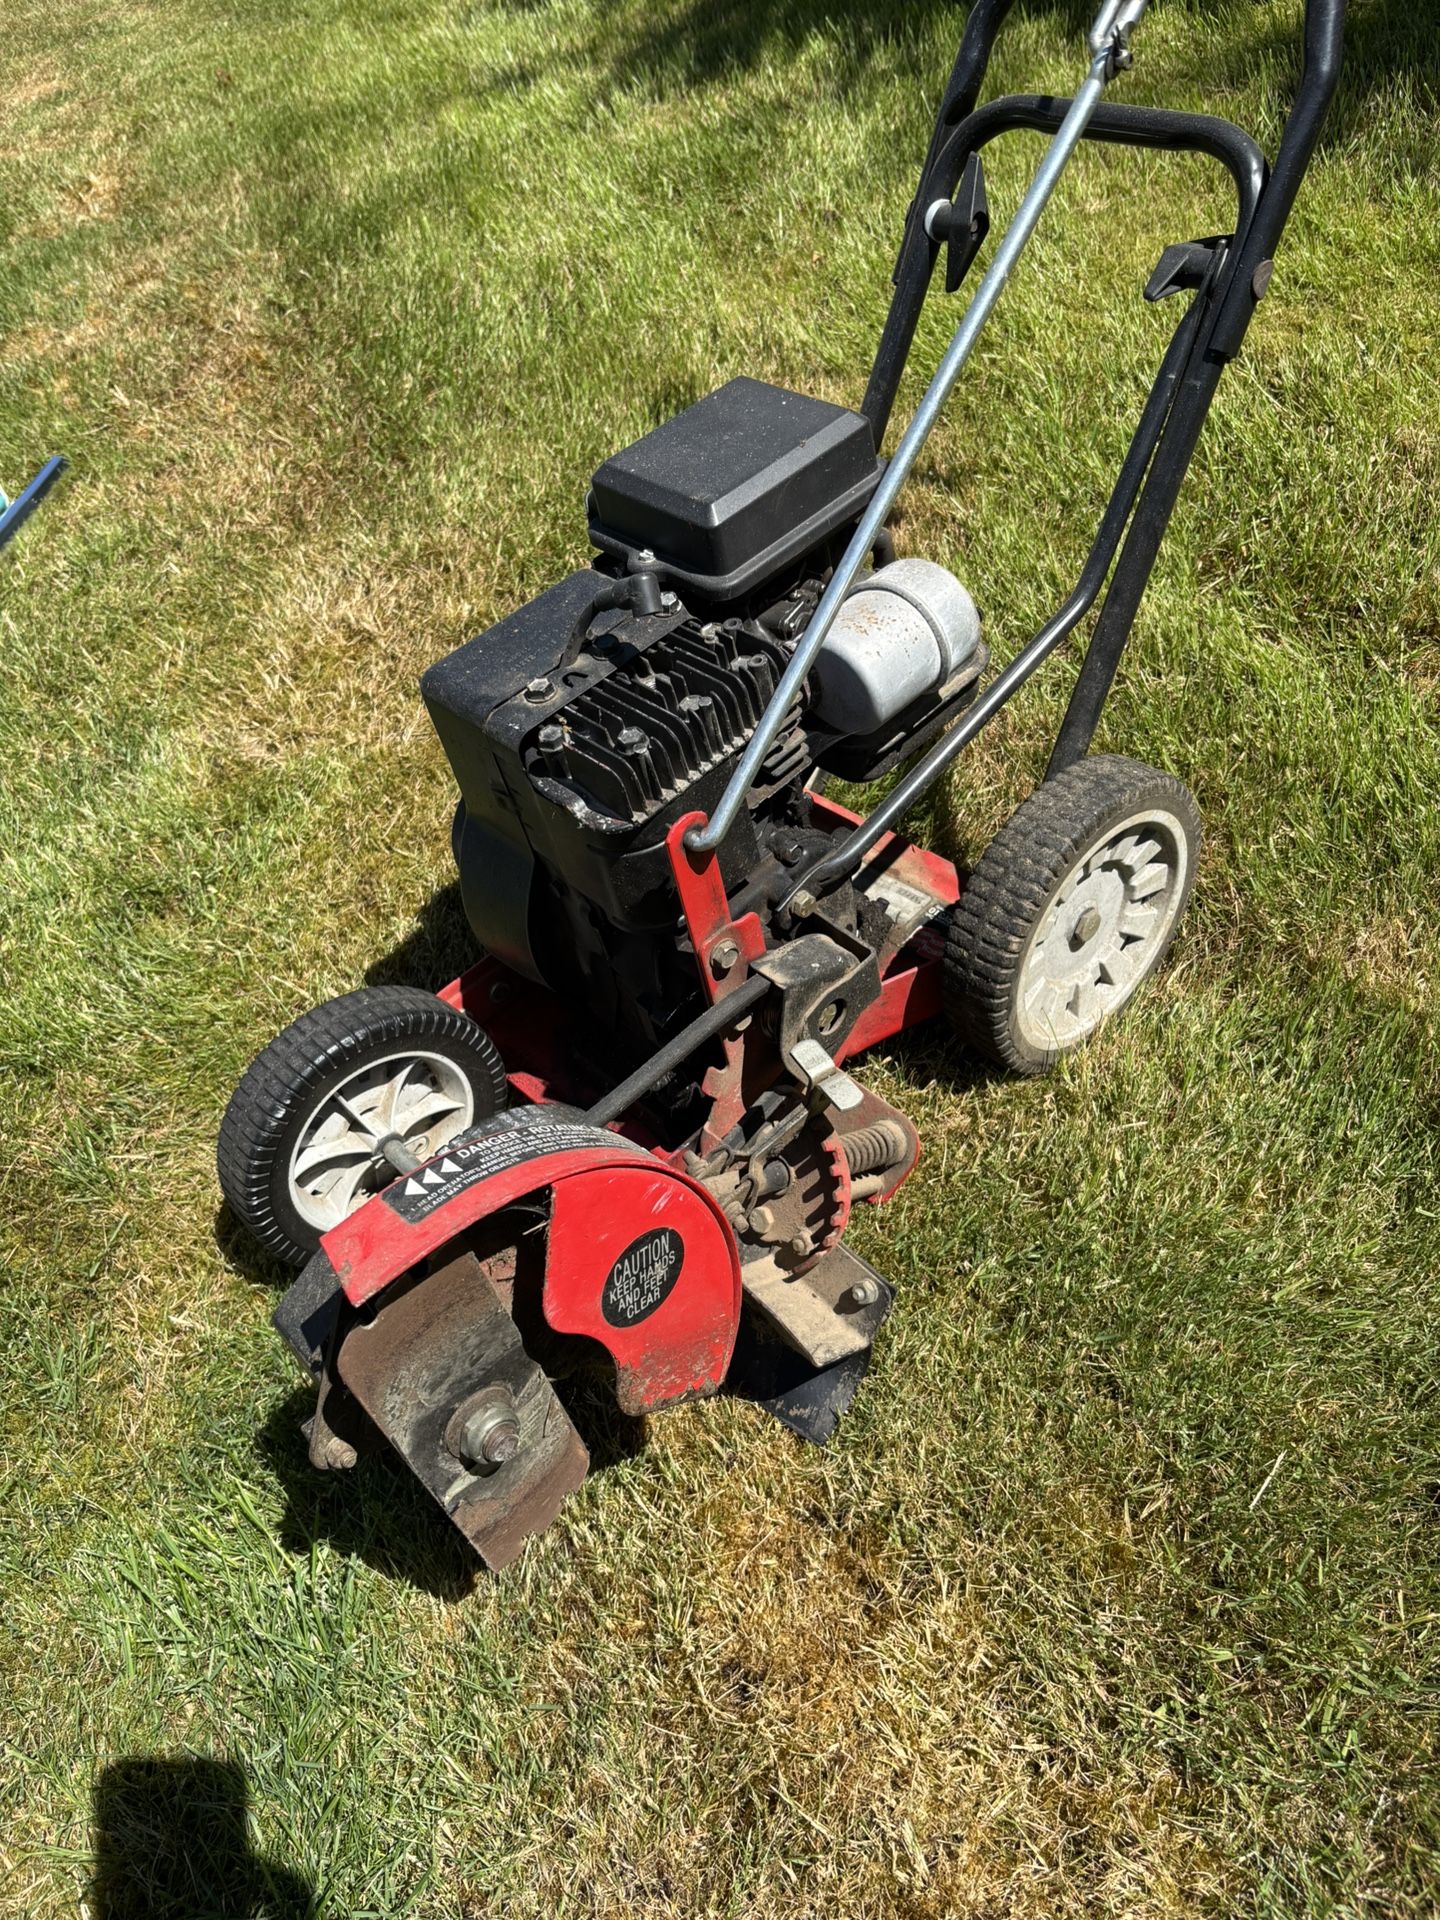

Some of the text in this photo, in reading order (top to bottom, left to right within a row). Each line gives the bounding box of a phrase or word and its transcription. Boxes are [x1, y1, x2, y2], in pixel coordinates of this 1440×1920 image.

[456, 1131, 521, 1159] DANGER
[479, 1151, 500, 1163] KEEP
[480, 1155, 510, 1169] MANUAL
[447, 1184, 463, 1196] MAY
[462, 1171, 488, 1186] THROW
[613, 1231, 670, 1287] CAUTION
[609, 1277, 636, 1304] KEEP
[618, 1267, 669, 1313] AND FEET
[626, 1286, 661, 1319] CLEAR
